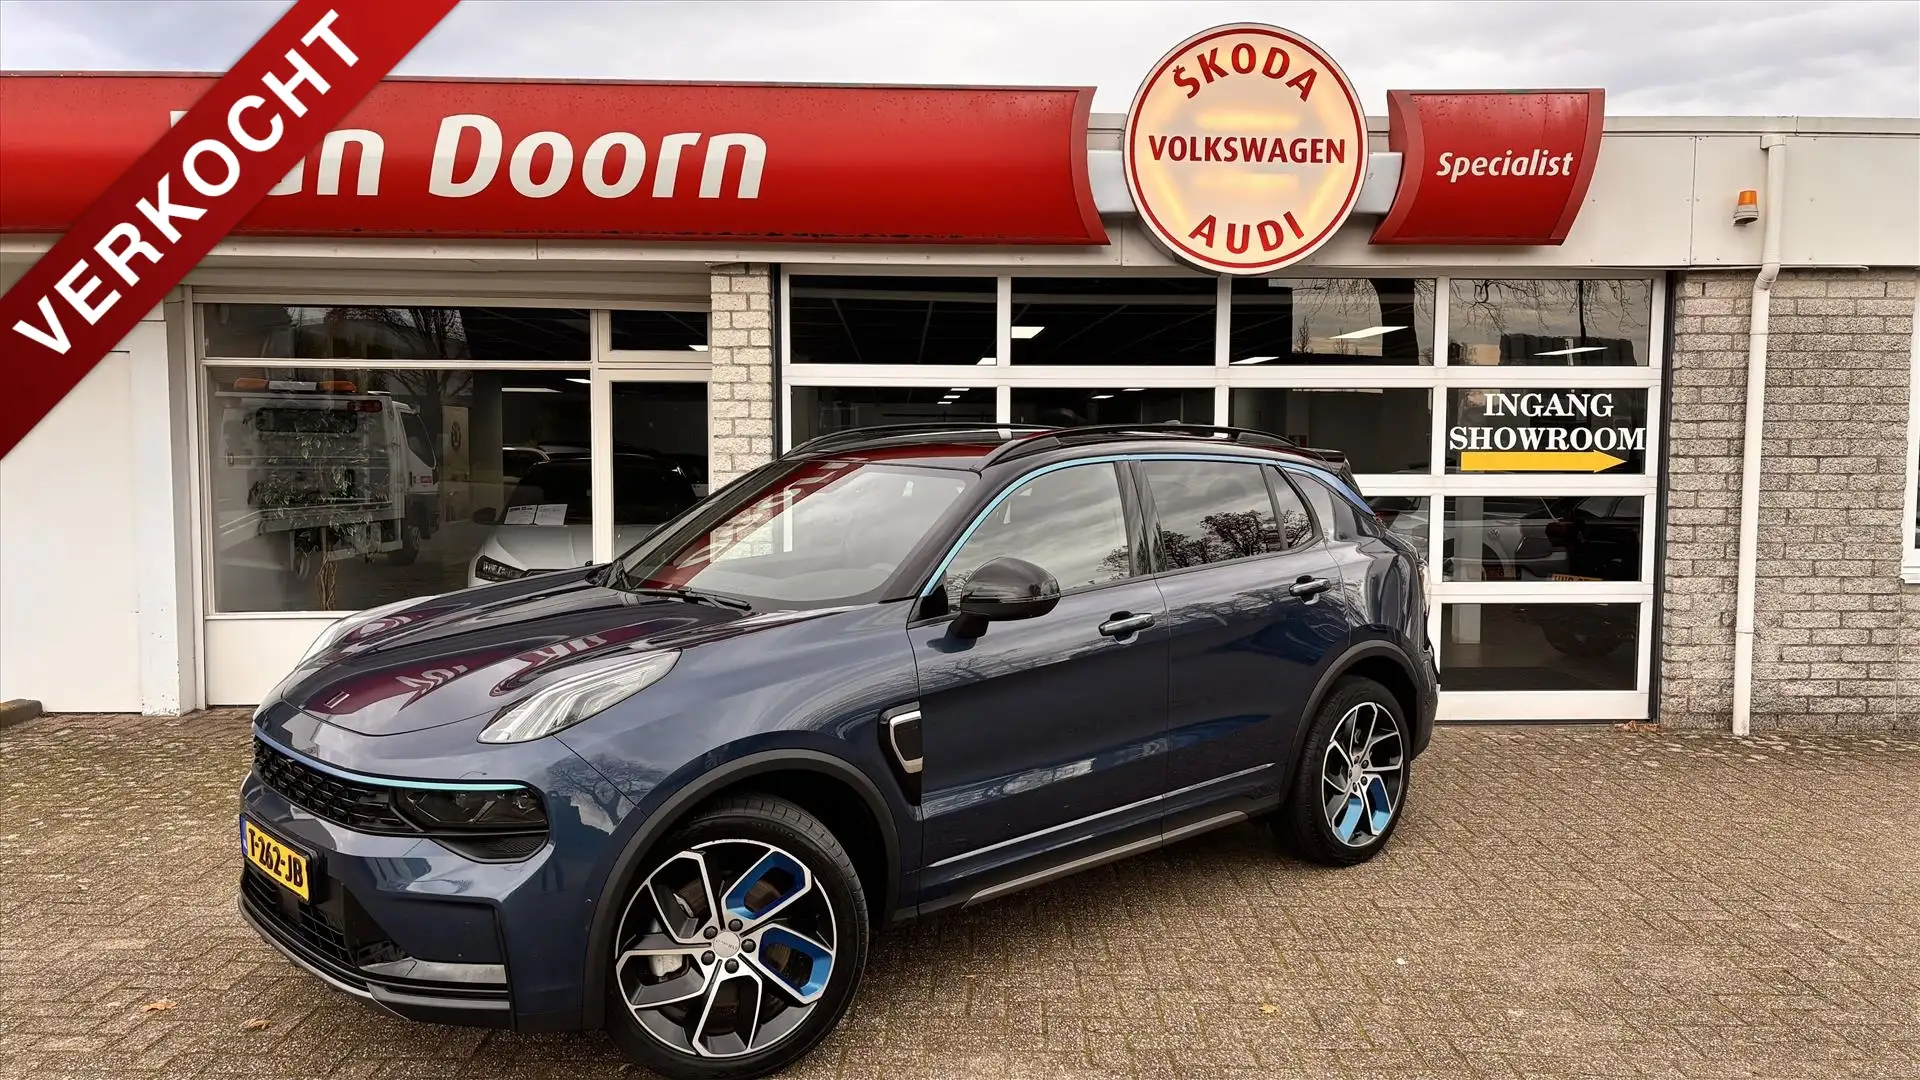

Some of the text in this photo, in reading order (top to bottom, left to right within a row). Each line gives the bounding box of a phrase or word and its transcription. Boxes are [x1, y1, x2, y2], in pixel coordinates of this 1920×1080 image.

[1172, 42, 1318, 102] ŠKODA
[428, 114, 767, 199] Doorn
[1148, 135, 1346, 164] VOLKSWAGEN
[1436, 148, 1574, 183] Specialist
[1188, 210, 1305, 255] AUDI
[1483, 392, 1615, 418] INGANG
[1449, 426, 1647, 451] SHOWROOM
[248, 827, 304, 888] T-262-JB
